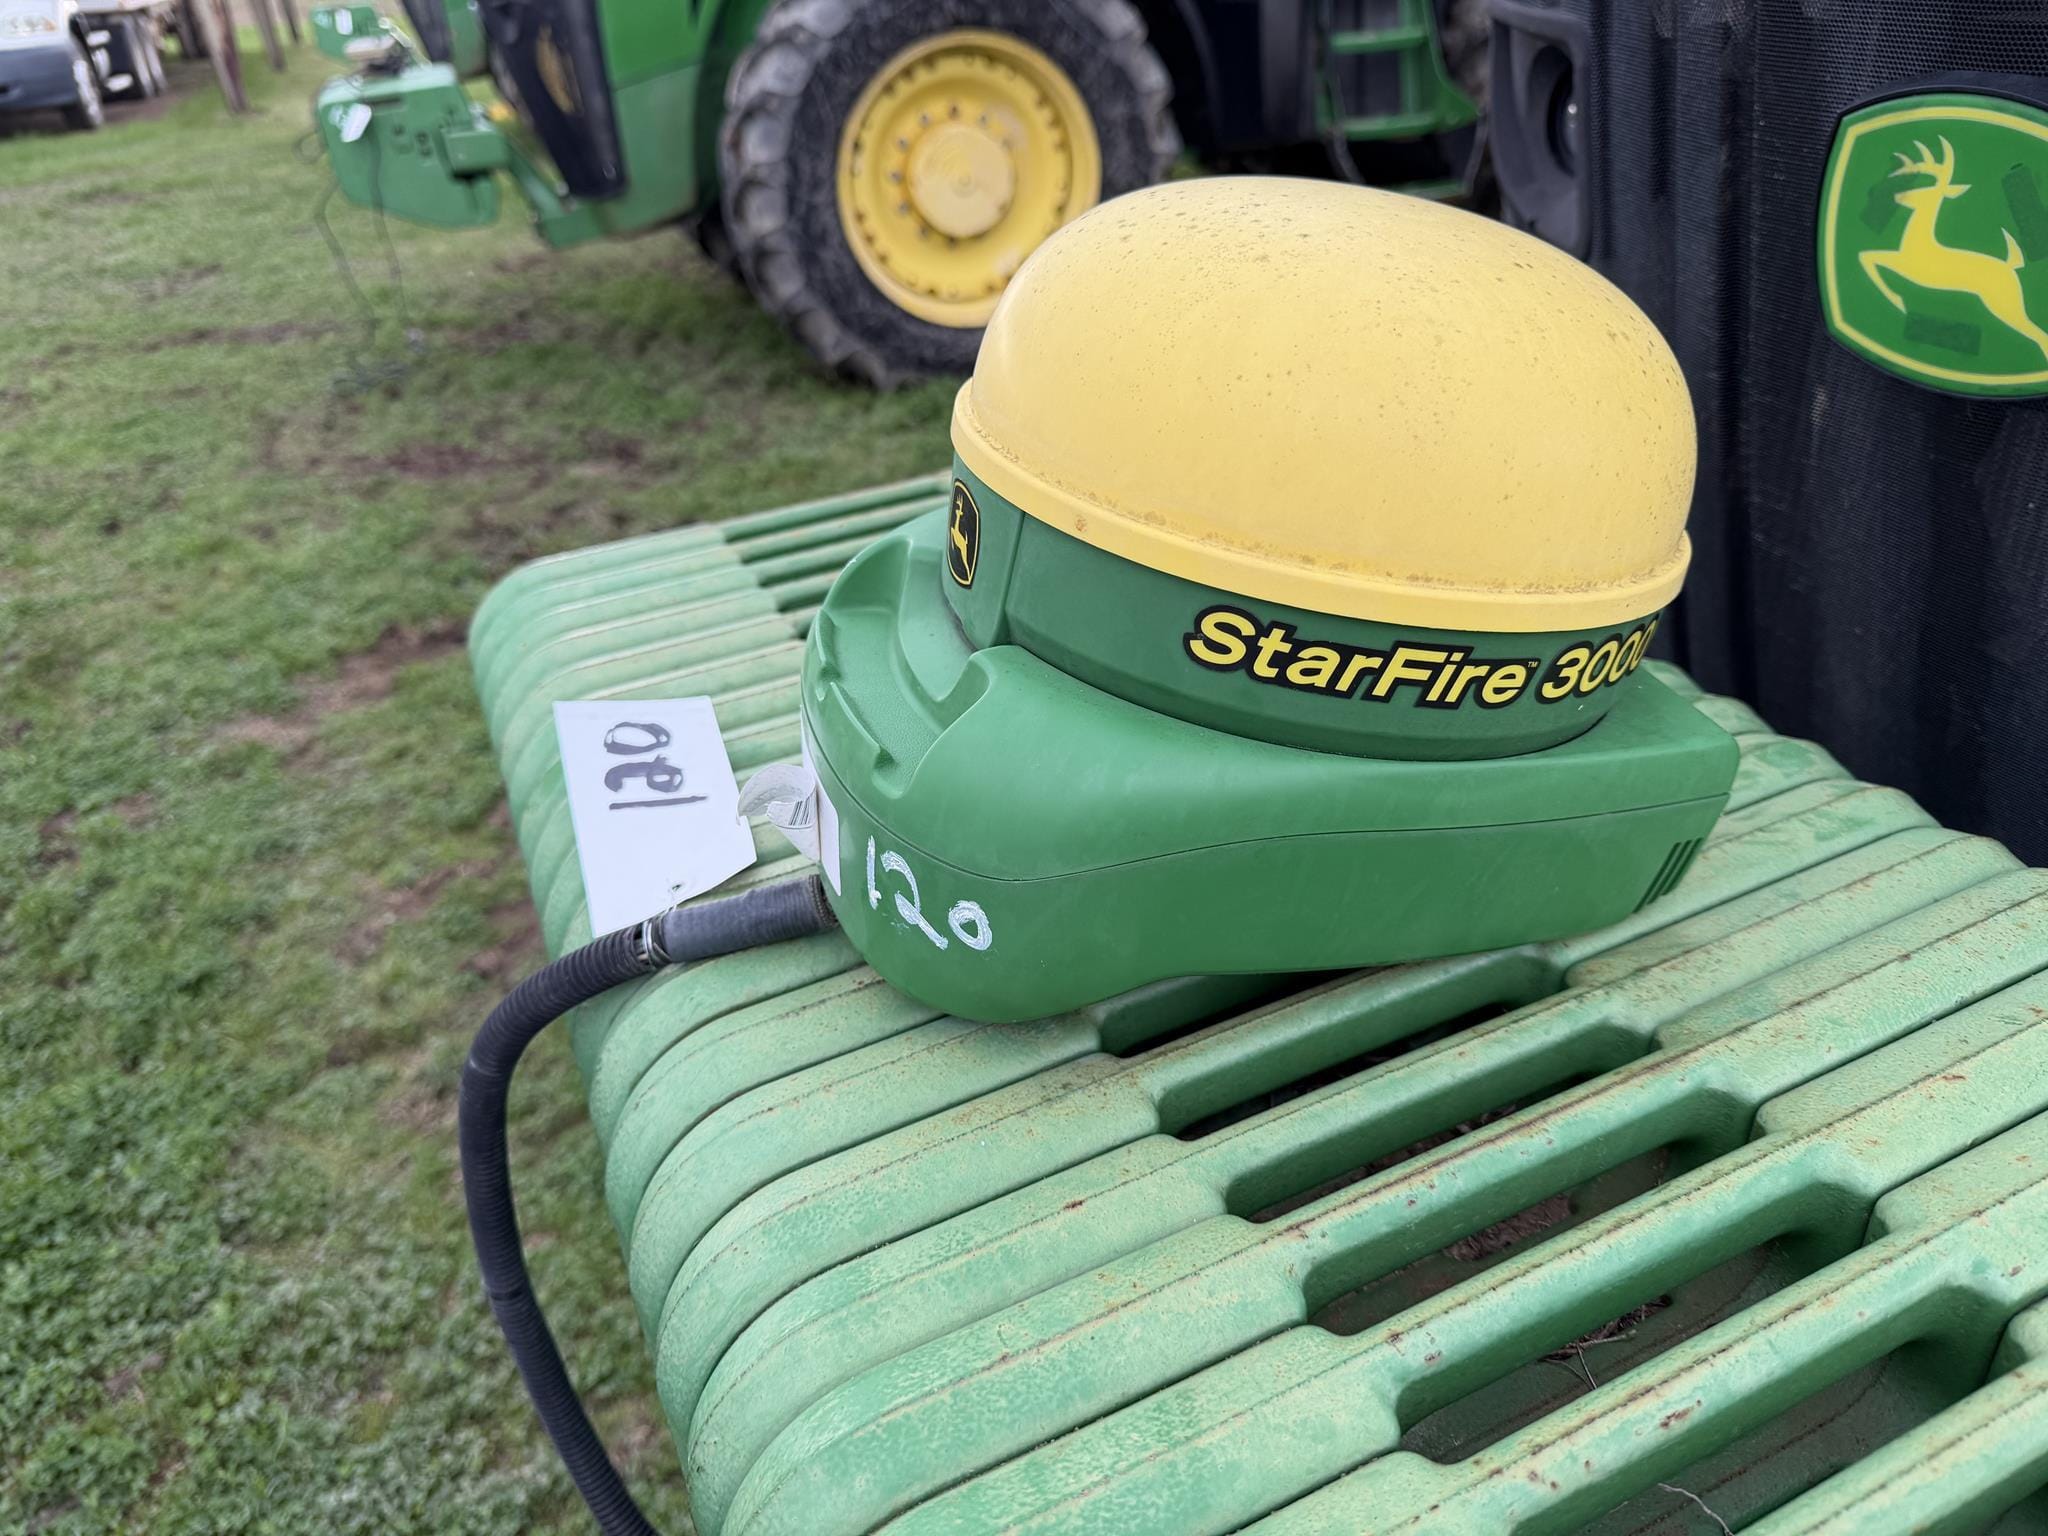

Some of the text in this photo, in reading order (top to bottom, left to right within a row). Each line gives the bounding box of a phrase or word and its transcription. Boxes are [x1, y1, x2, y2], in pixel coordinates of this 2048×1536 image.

[1541, 619, 1658, 700] 3000
[602, 720, 709, 810] 120
[865, 835, 995, 952] 120
